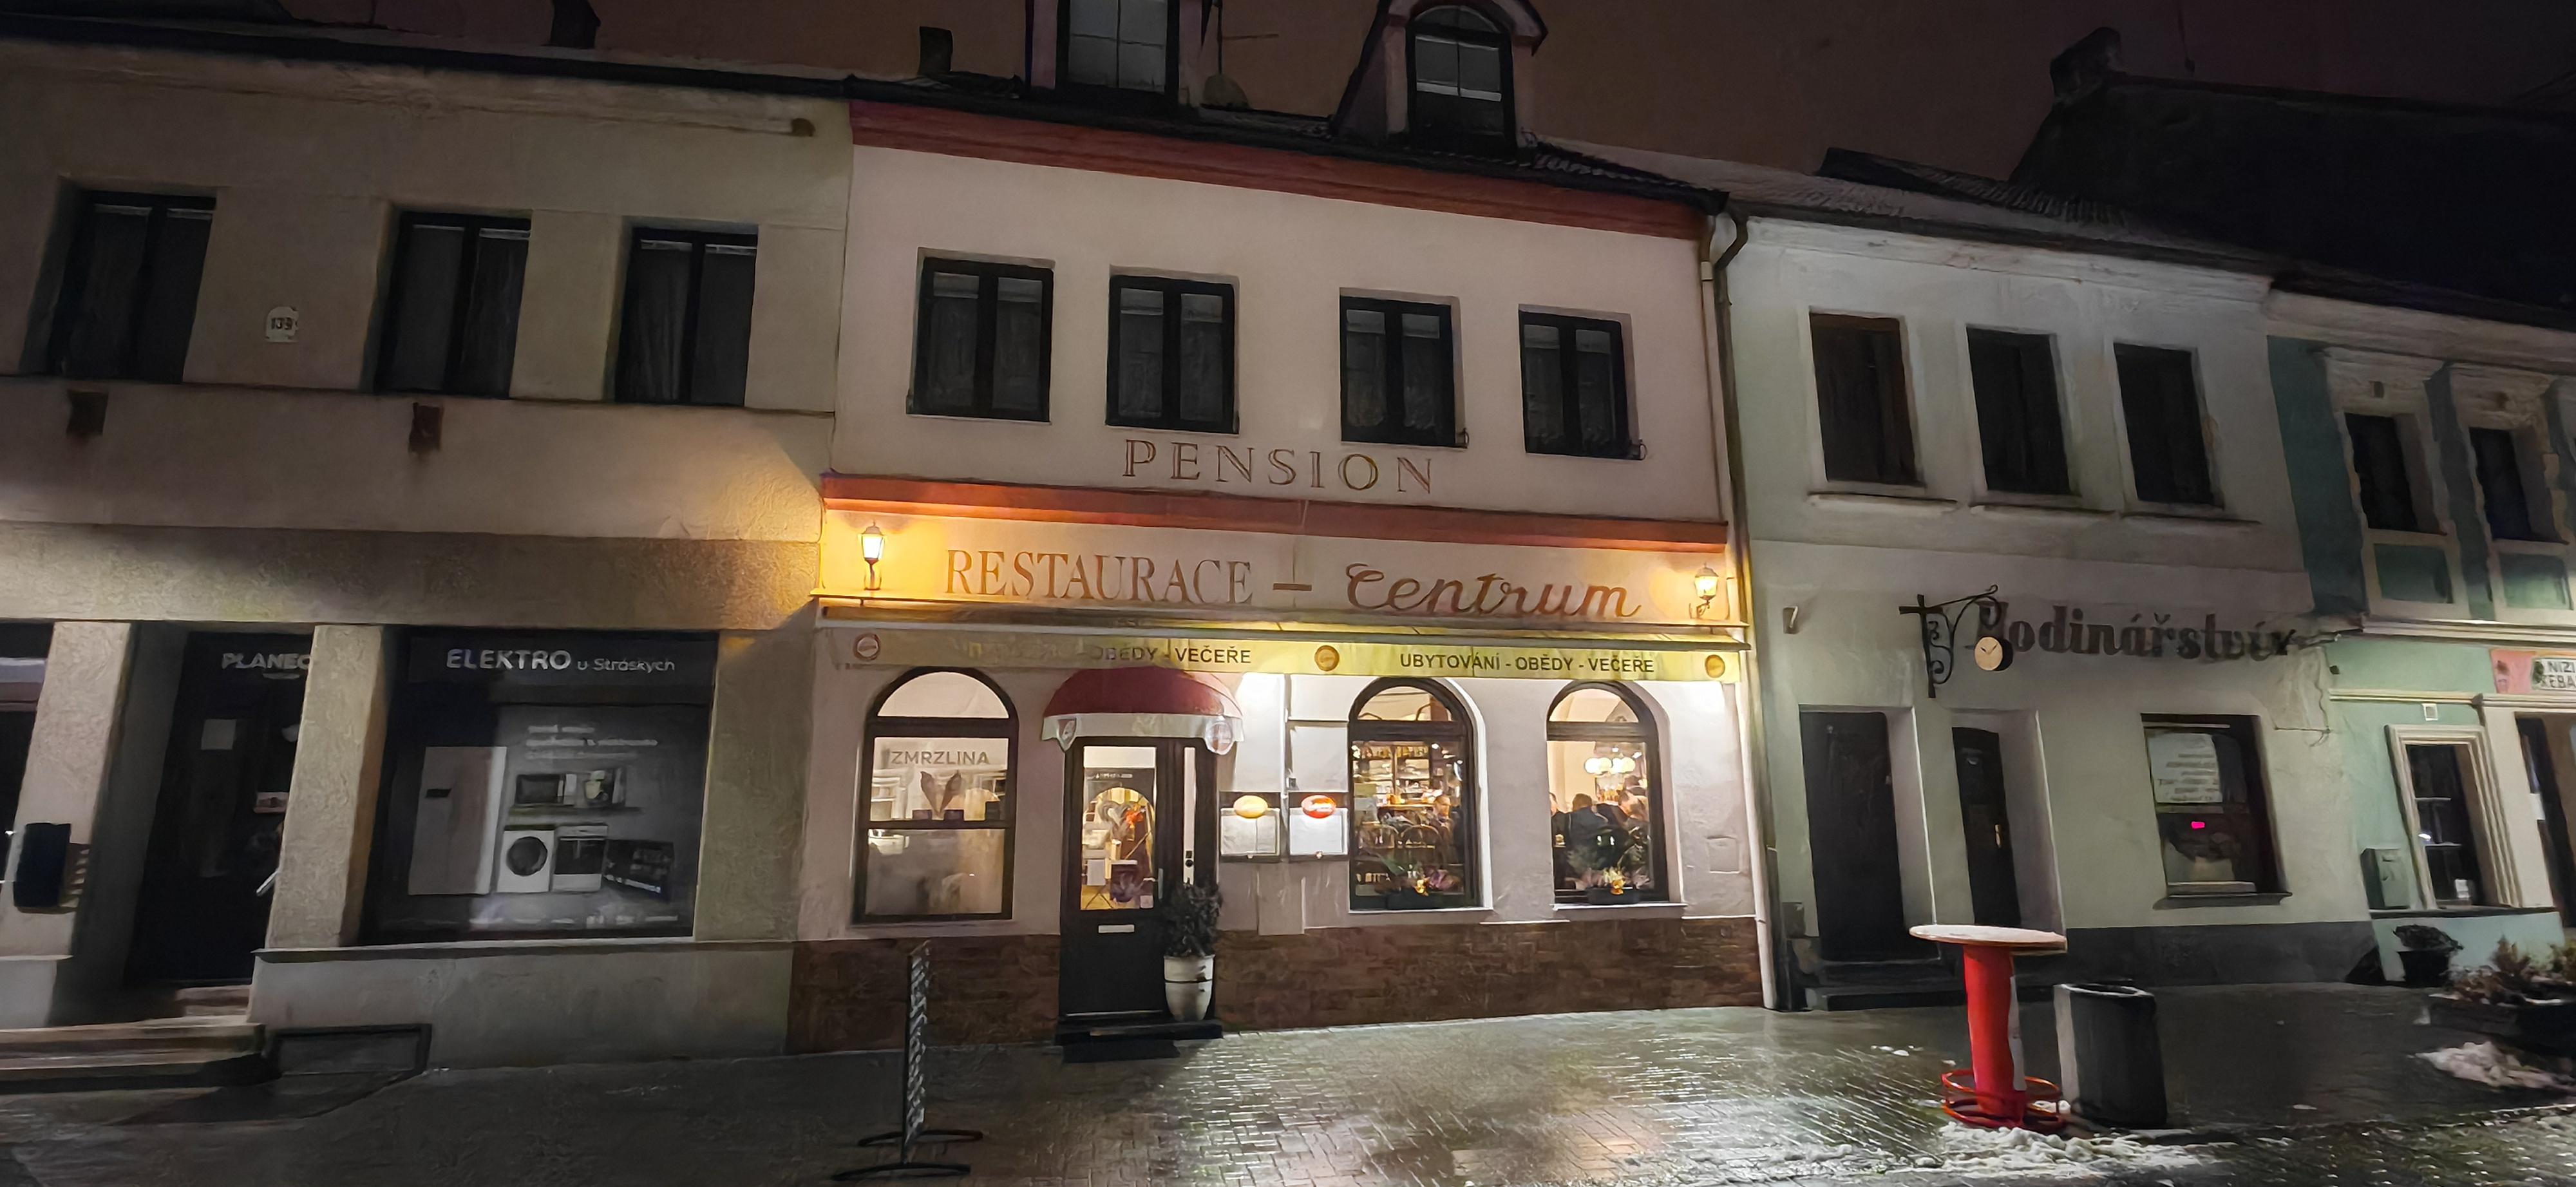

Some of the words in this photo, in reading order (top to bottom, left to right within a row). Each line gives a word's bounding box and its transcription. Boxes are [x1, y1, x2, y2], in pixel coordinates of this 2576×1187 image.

[1122, 439, 1432, 494] PENSION
[945, 549, 1253, 604] RESTAURACE
[1345, 562, 1642, 618] Centrum
[446, 648, 572, 670] ELEKTRO
[577, 660, 589, 670] u
[1174, 645, 1252, 664] VEČEŘE
[1399, 652, 1501, 670] UBYTOVÁNÍ
[1515, 653, 1573, 672] OBĚDY
[1588, 654, 1655, 673] VEČEŘE
[891, 750, 990, 765] ZMRZLINA
